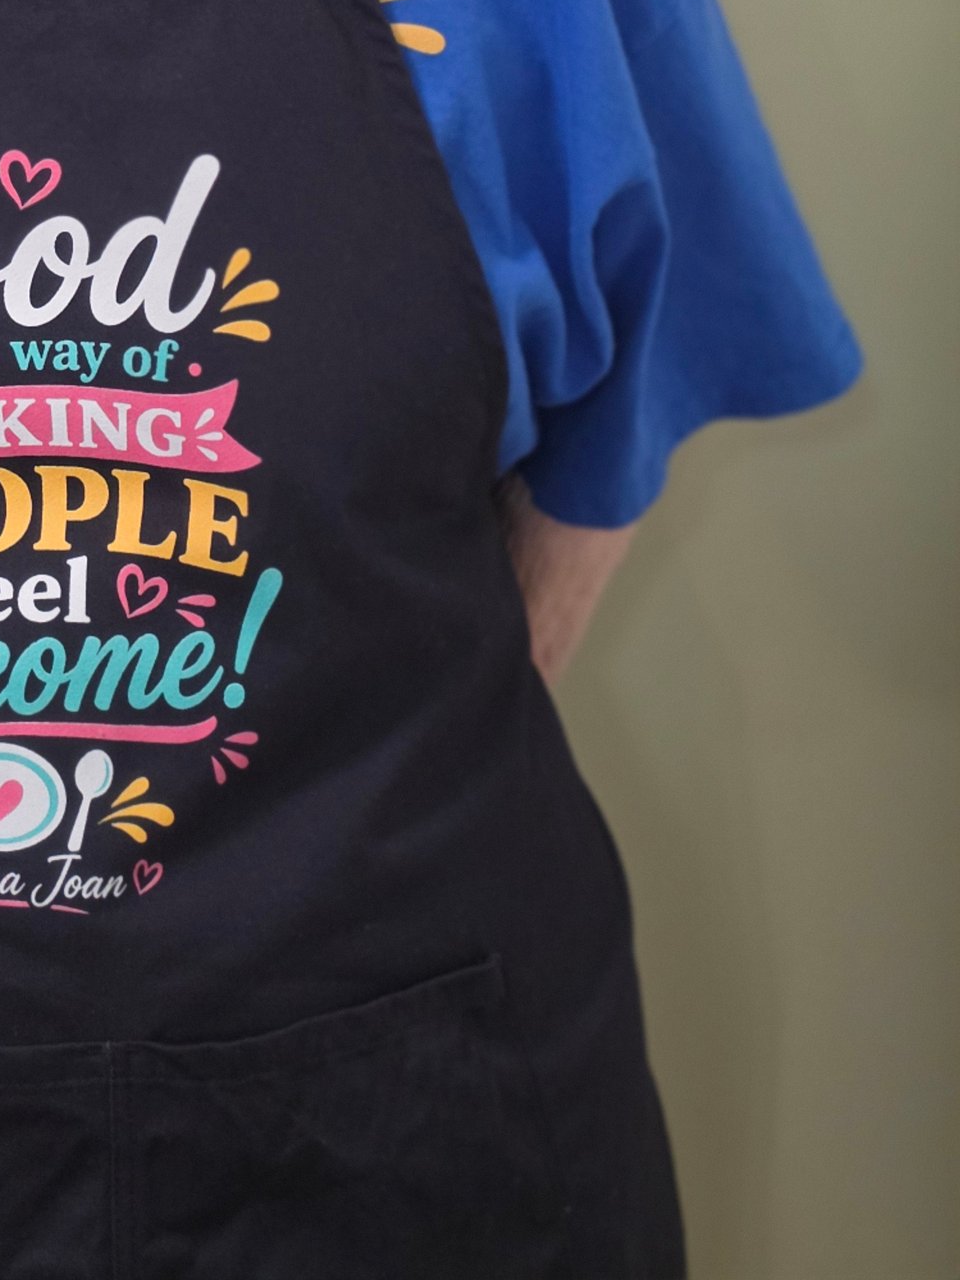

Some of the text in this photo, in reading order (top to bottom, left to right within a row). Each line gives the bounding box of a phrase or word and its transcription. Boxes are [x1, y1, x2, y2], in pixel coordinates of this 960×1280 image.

[10, 339, 111, 382] way
[122, 339, 180, 383] of
[31, 853, 127, 907] Joan
